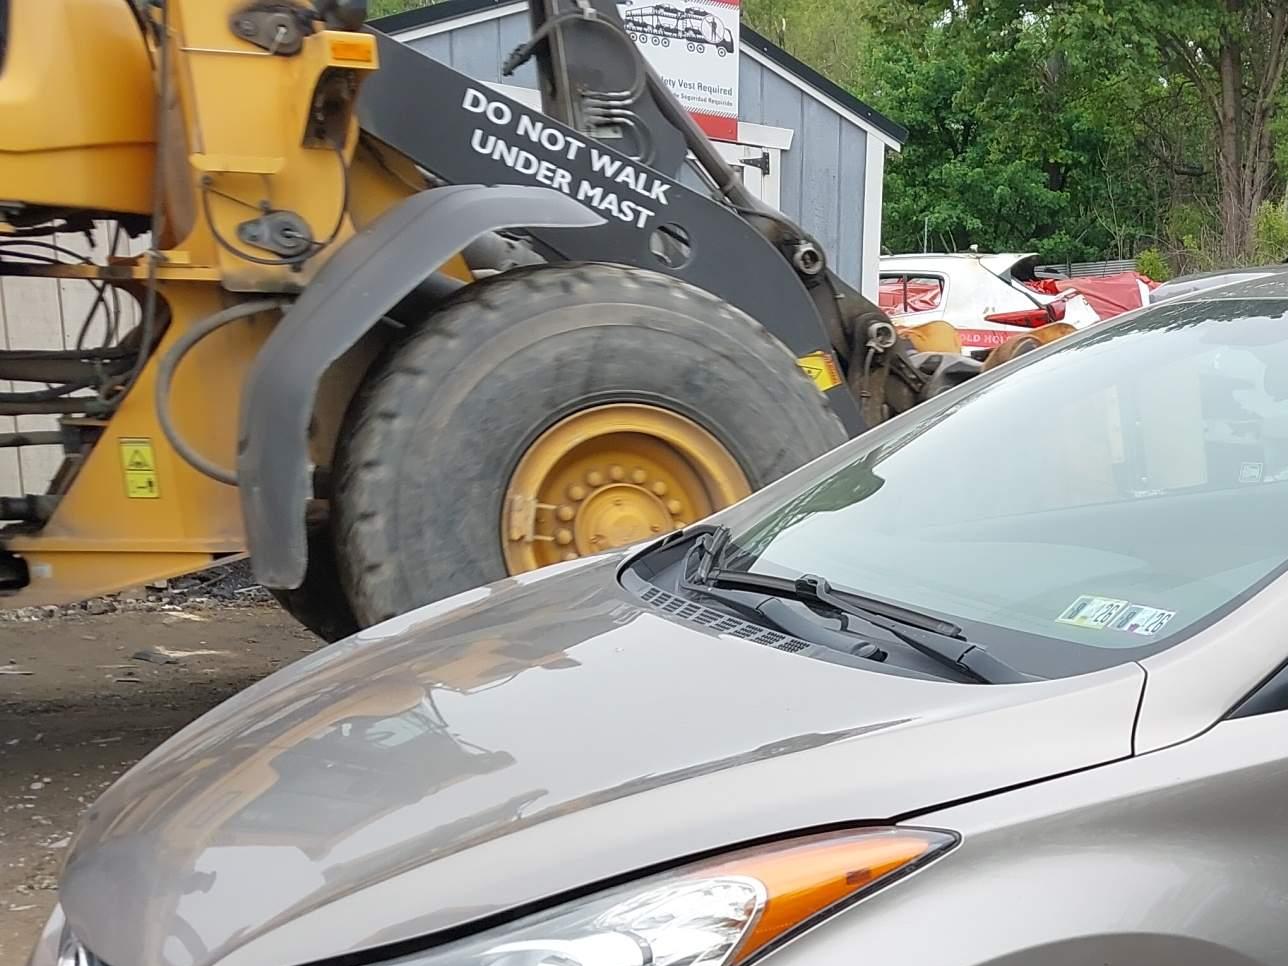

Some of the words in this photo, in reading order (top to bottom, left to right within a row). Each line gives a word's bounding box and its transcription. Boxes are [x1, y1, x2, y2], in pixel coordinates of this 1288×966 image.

[678, 79, 695, 89] Vest
[697, 82, 733, 96] Required
[461, 88, 512, 125] DO
[516, 114, 586, 160] NOT
[590, 148, 672, 205] WALK
[471, 128, 573, 194] UNDER
[577, 180, 656, 229] MAST
